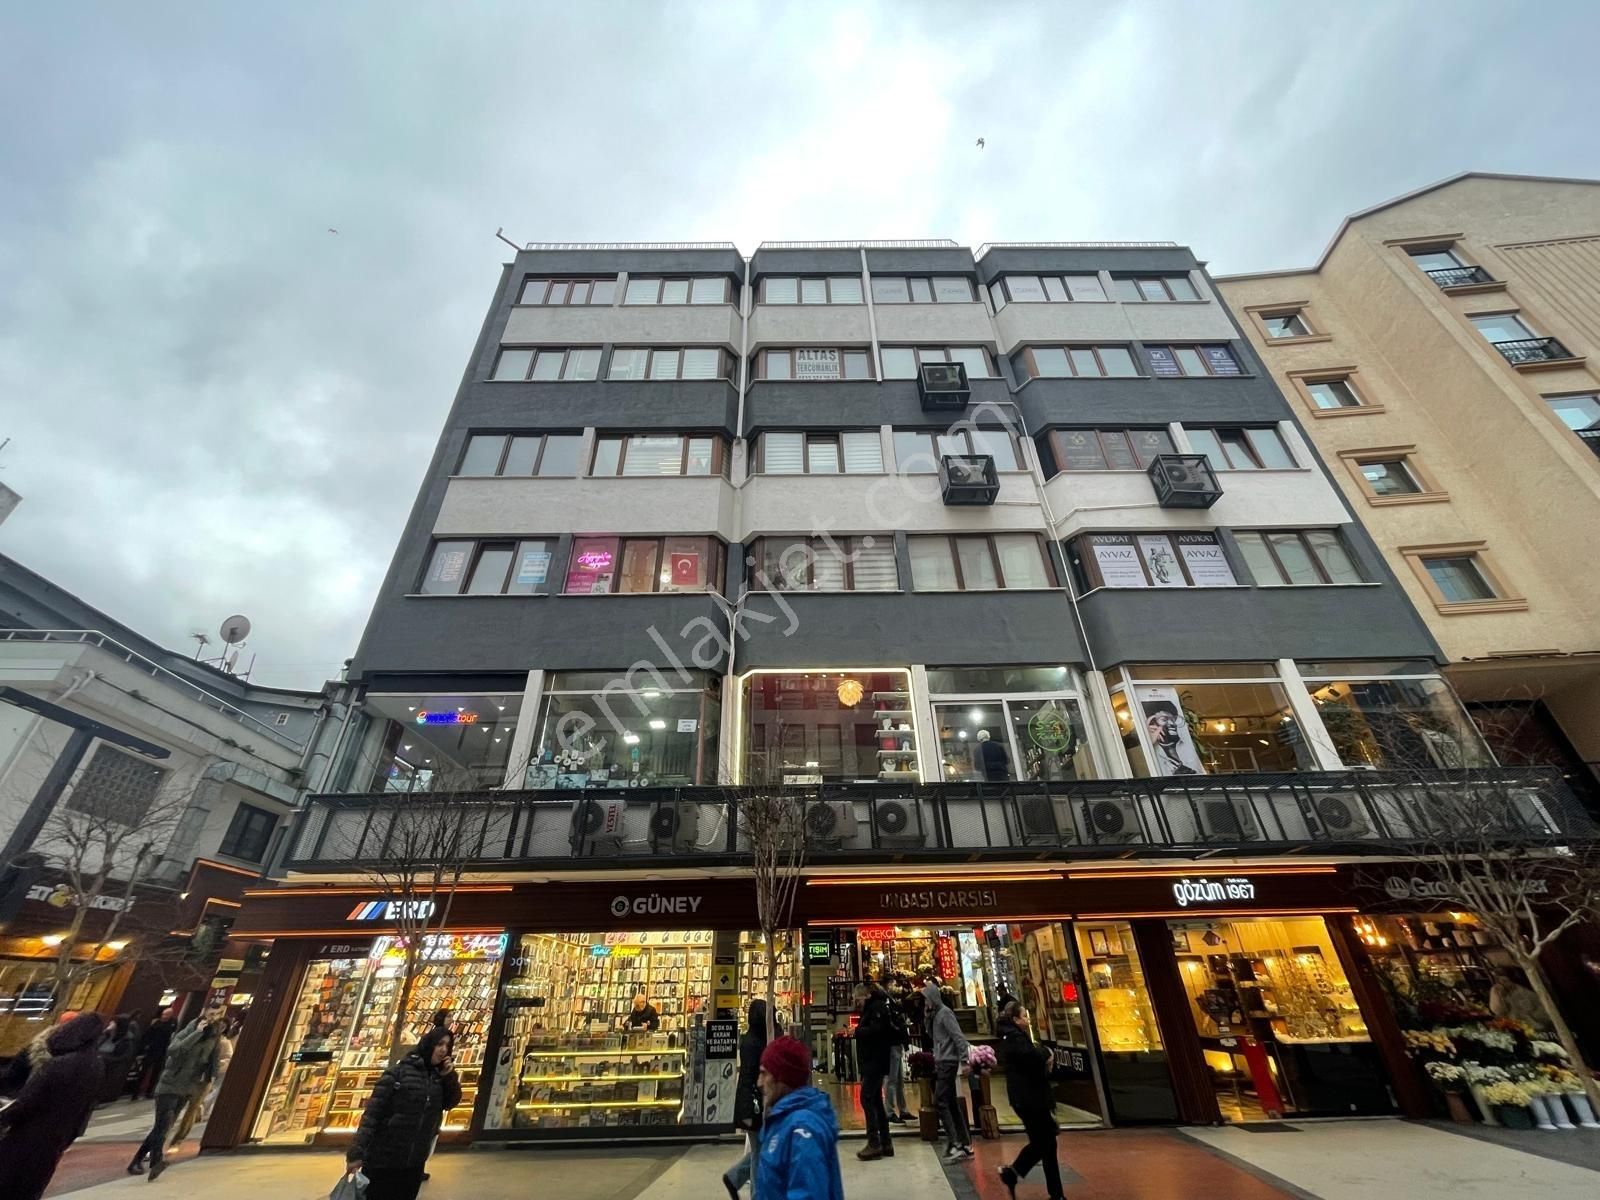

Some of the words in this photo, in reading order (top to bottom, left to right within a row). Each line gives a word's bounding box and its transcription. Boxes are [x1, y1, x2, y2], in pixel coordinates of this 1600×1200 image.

[798, 350, 837, 362] ALTAŞ
[1091, 535, 1128, 543] AVUKAT
[1178, 535, 1214, 543] AVUKAT
[1100, 551, 1133, 559] AYVAZ
[606, 804, 617, 833] VESTEL
[1173, 879, 1227, 907] gözüm
[1226, 884, 1255, 899] 1967
[632, 893, 702, 914] GÜNEY
[384, 900, 436, 920] ERD
[330, 945, 351, 953] ERD
